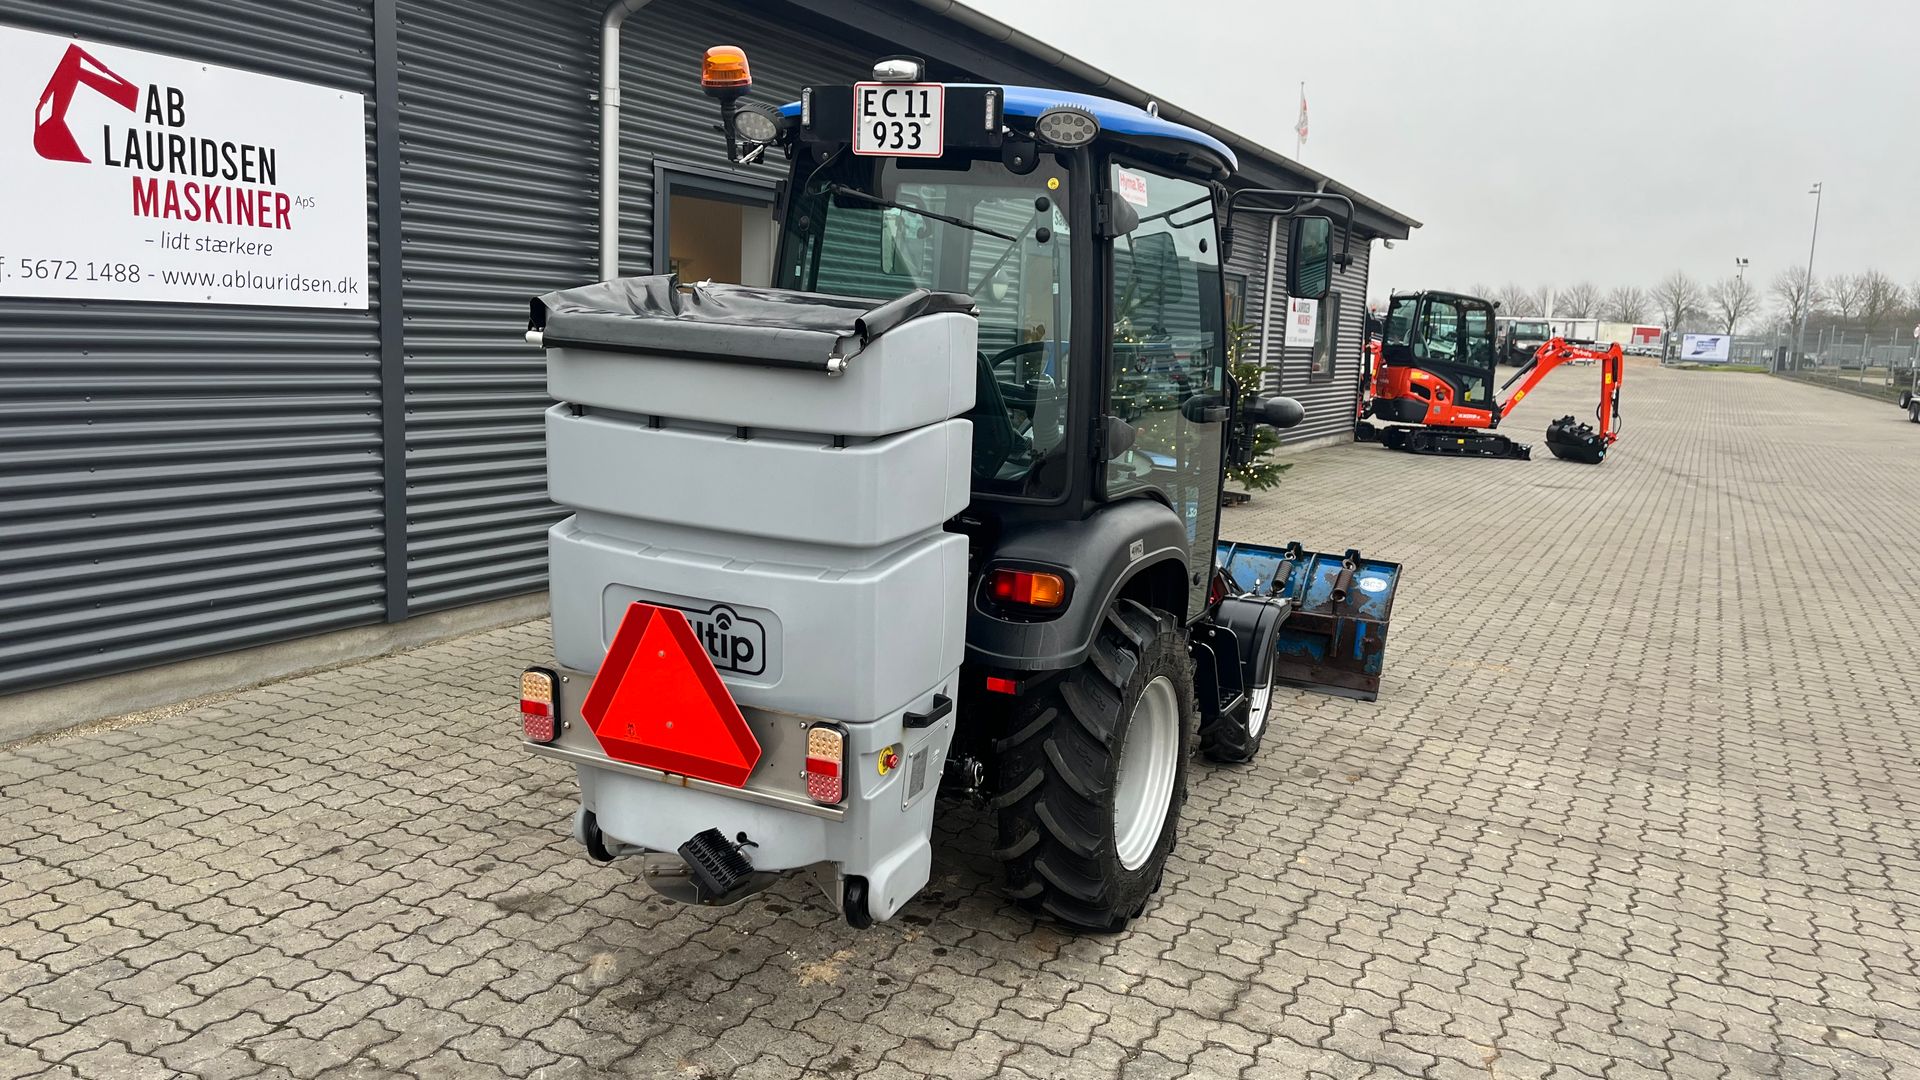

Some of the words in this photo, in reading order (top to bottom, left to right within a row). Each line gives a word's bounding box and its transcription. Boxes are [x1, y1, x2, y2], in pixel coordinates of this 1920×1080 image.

[144, 83, 186, 128] AB
[103, 124, 277, 186] LAURIDSEN
[873, 121, 922, 149] 933
[132, 175, 292, 231] MASKINER
[294, 195, 316, 211] ApS
[160, 230, 191, 251] lidt
[195, 235, 274, 257] stærkere
[20, 258, 79, 280] 5672
[86, 261, 141, 284] 1488
[161, 269, 359, 295] www.ablauridsen.dk
